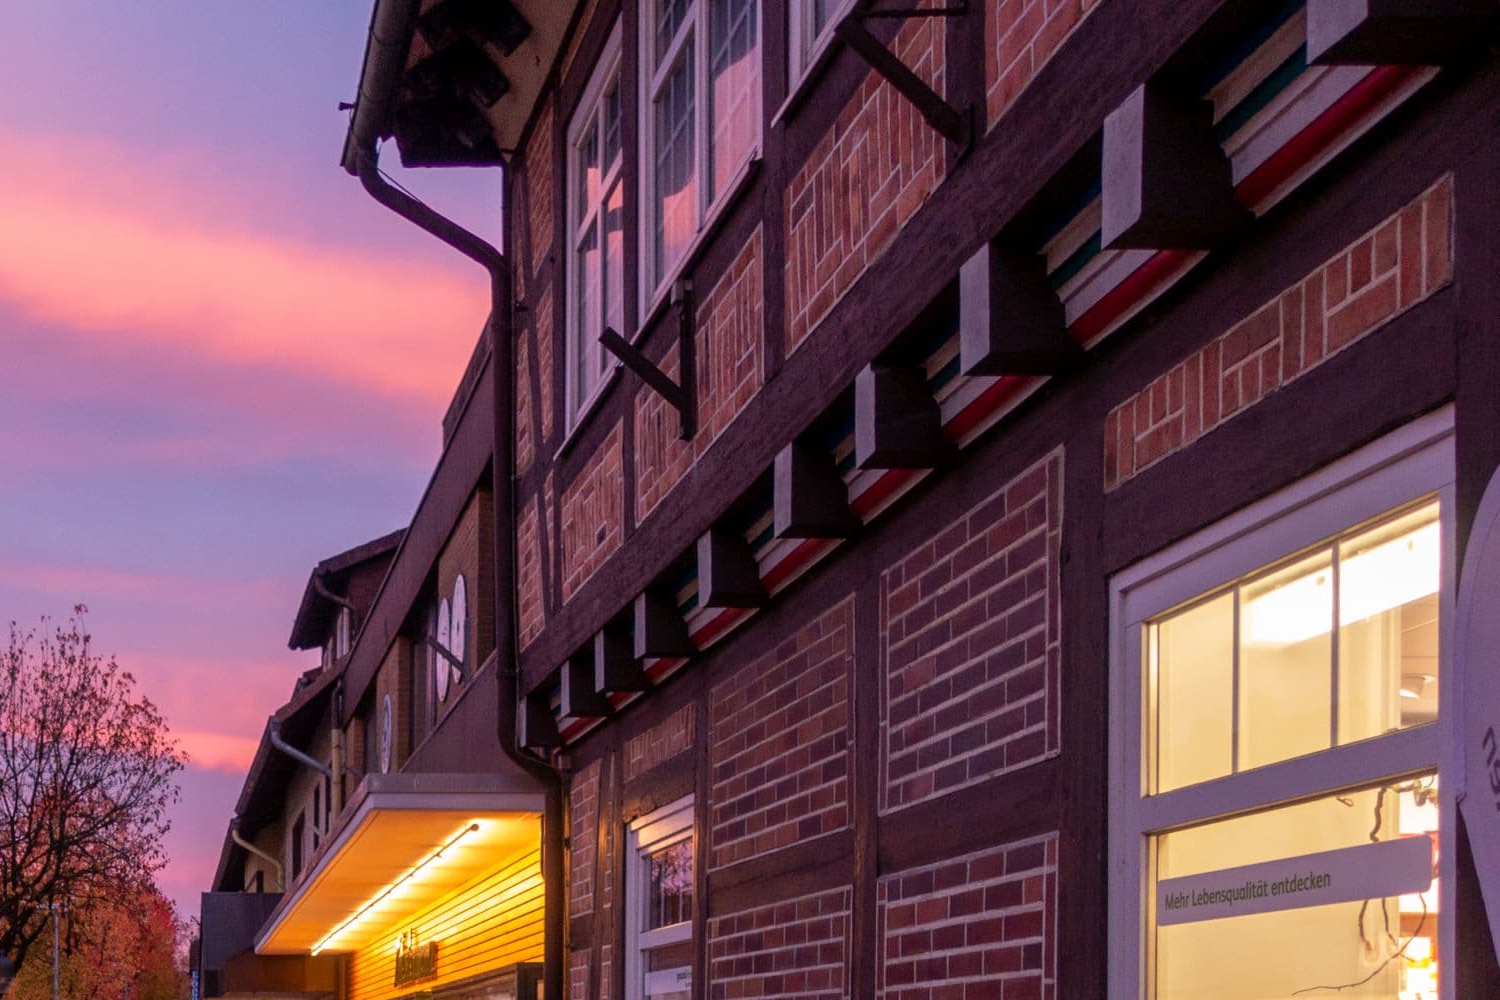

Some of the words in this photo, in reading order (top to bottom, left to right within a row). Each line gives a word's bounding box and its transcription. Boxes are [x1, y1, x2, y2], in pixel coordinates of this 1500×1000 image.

[1164, 889, 1190, 911] Mehr
[1191, 876, 1269, 908] Lebensqualität
[1270, 869, 1331, 897] entdecken
